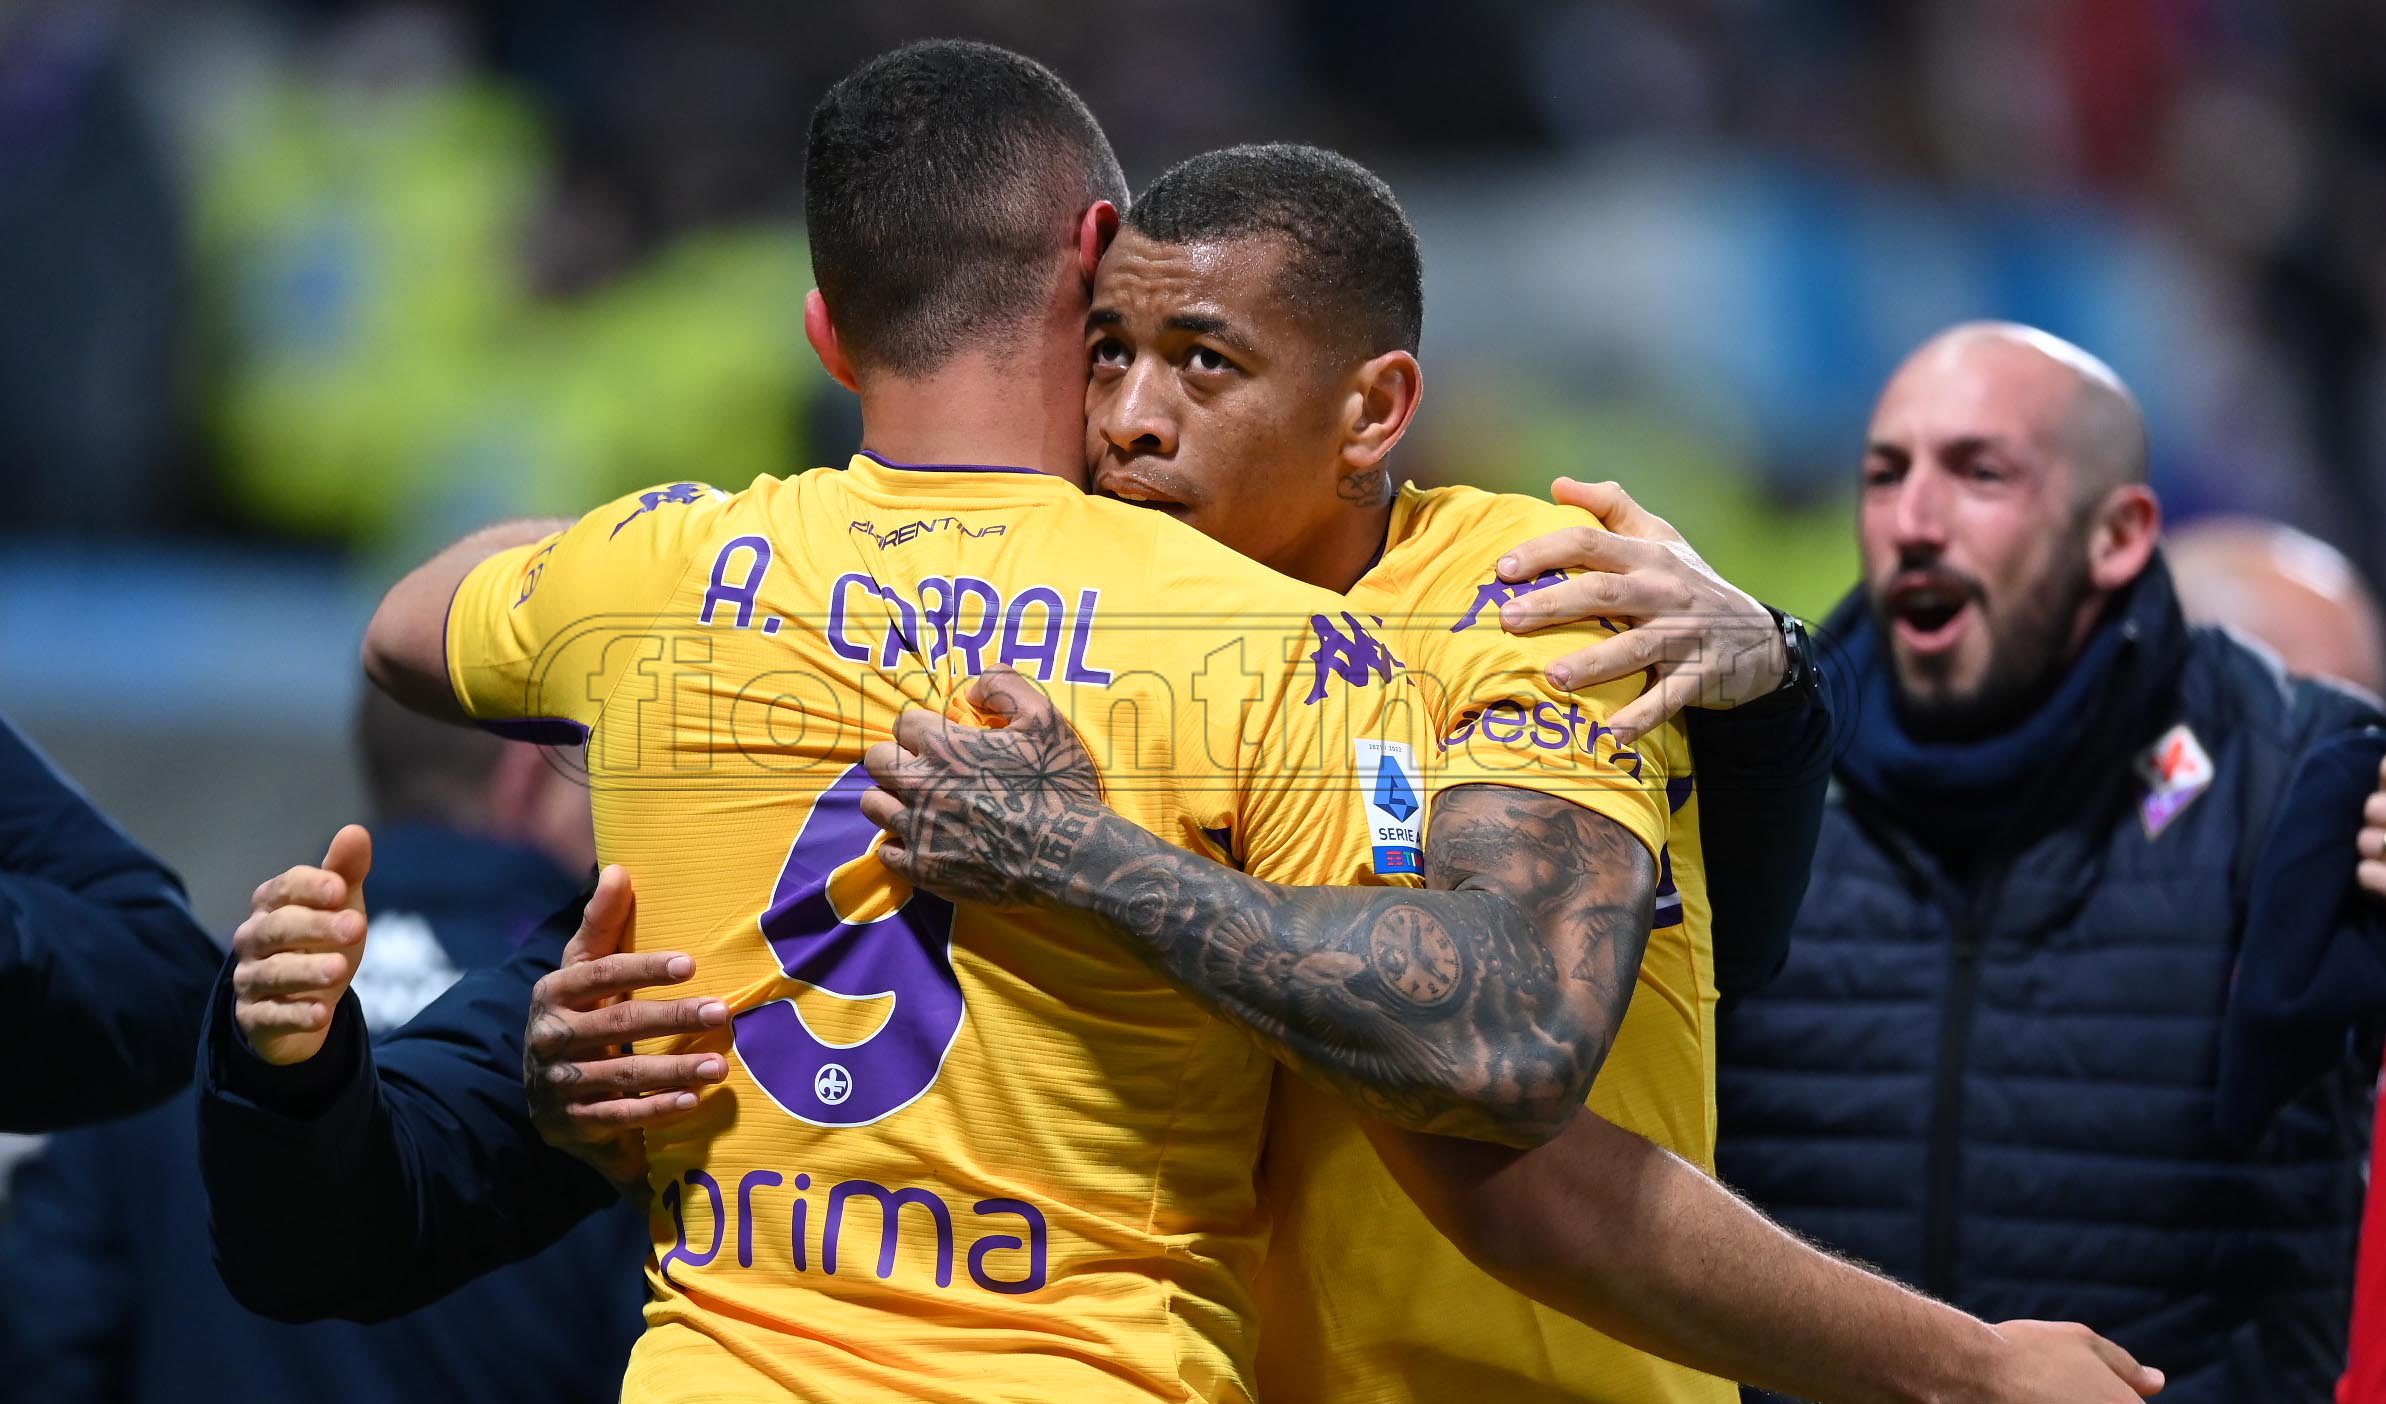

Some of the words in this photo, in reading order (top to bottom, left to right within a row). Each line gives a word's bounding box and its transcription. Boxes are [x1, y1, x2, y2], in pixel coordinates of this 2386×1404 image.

[699, 534, 783, 636] A.
[826, 572, 1115, 686] CABRAL
[1379, 827, 1415, 843] SERIE
[661, 1169, 1048, 1295] prima
